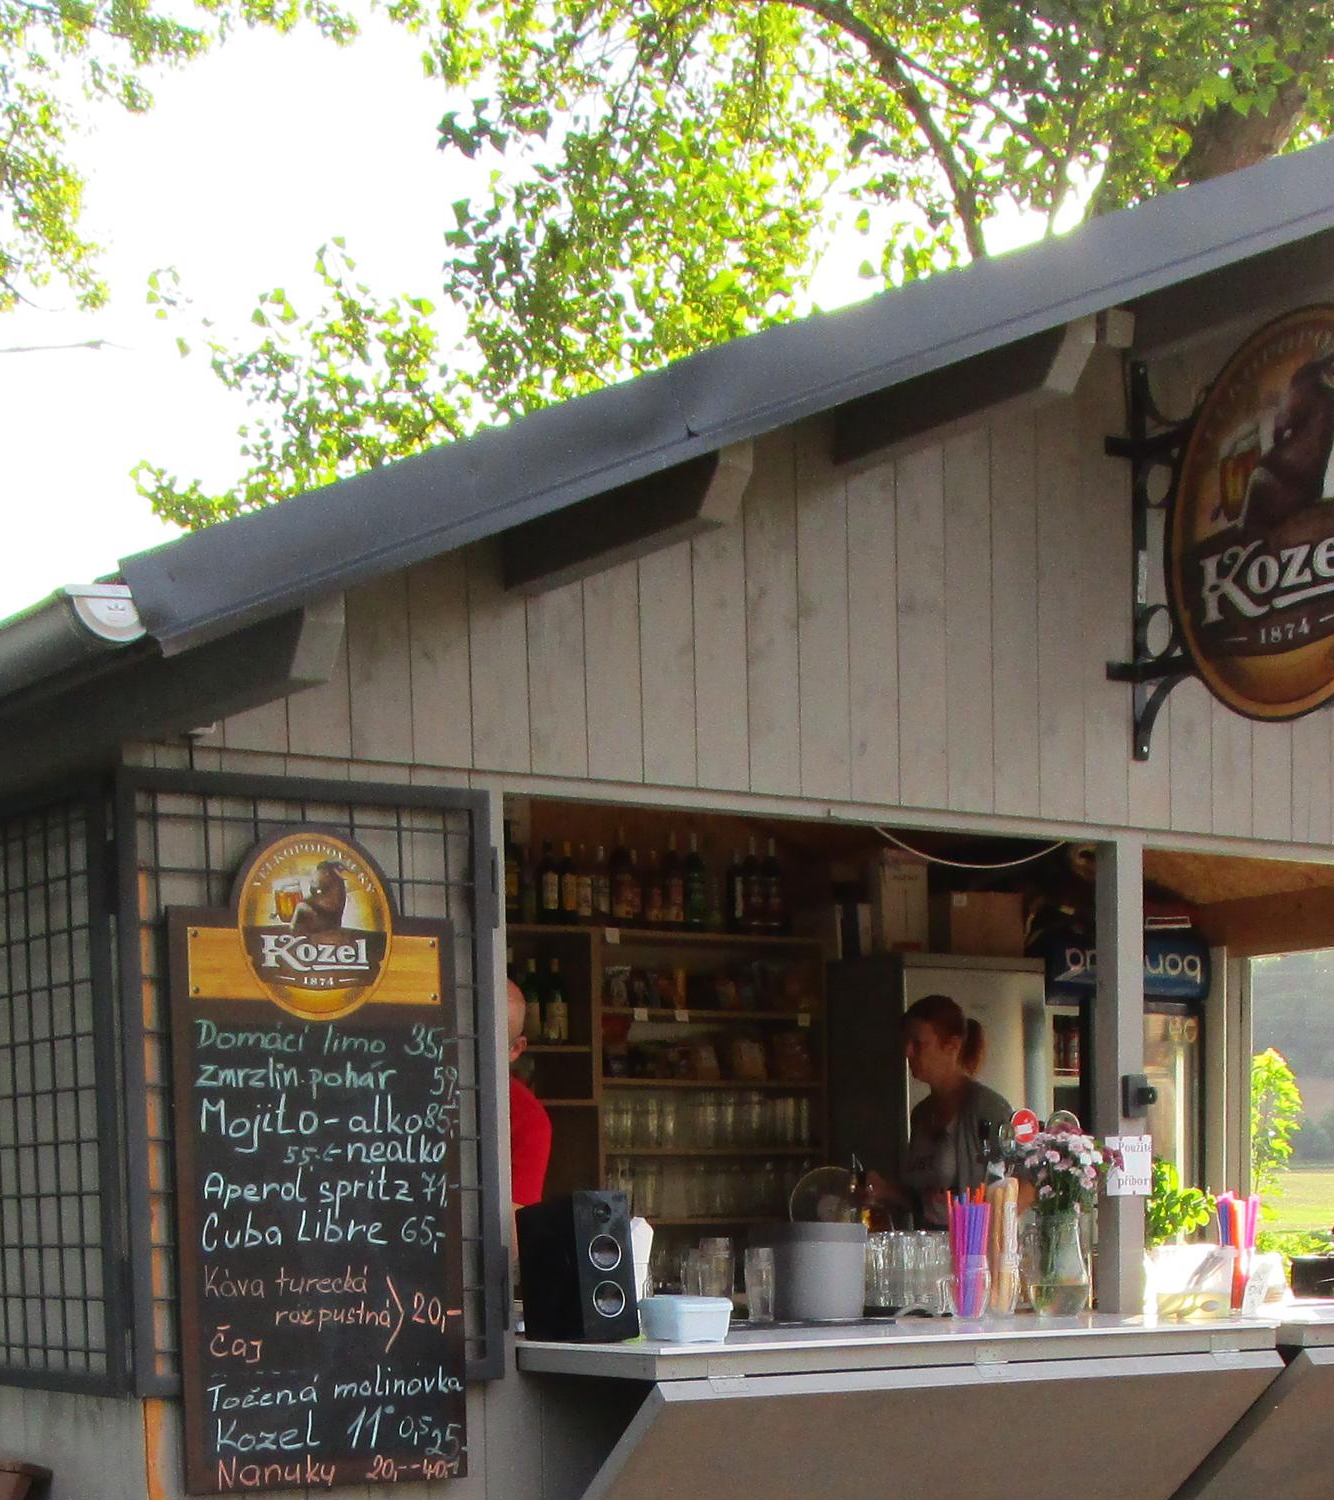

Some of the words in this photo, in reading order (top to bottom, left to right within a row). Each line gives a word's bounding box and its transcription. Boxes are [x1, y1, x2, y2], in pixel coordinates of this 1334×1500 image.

[1259, 616, 1310, 644] 1874
[260, 934, 370, 972] Kozel
[302, 976, 335, 987] 1874
[195, 1019, 309, 1051] Domácí
[309, 1060, 397, 1099] pohár
[200, 1093, 319, 1153] Mojito
[348, 1094, 423, 1134] alko
[347, 1134, 447, 1163] nealko
[204, 1166, 308, 1210] Aperol
[319, 1165, 414, 1220] spritz
[1118, 1175, 1149, 1188] příbor
[202, 1210, 283, 1252] Cuba
[297, 1208, 388, 1245] Libre
[204, 1264, 265, 1298] Káva
[275, 1264, 368, 1297] turecká
[210, 1324, 264, 1364] Čaj
[207, 1373, 319, 1413] Točená
[334, 1363, 464, 1400] malinovka
[217, 1409, 321, 1453] Kozel
[218, 1453, 337, 1492] Nanuky
